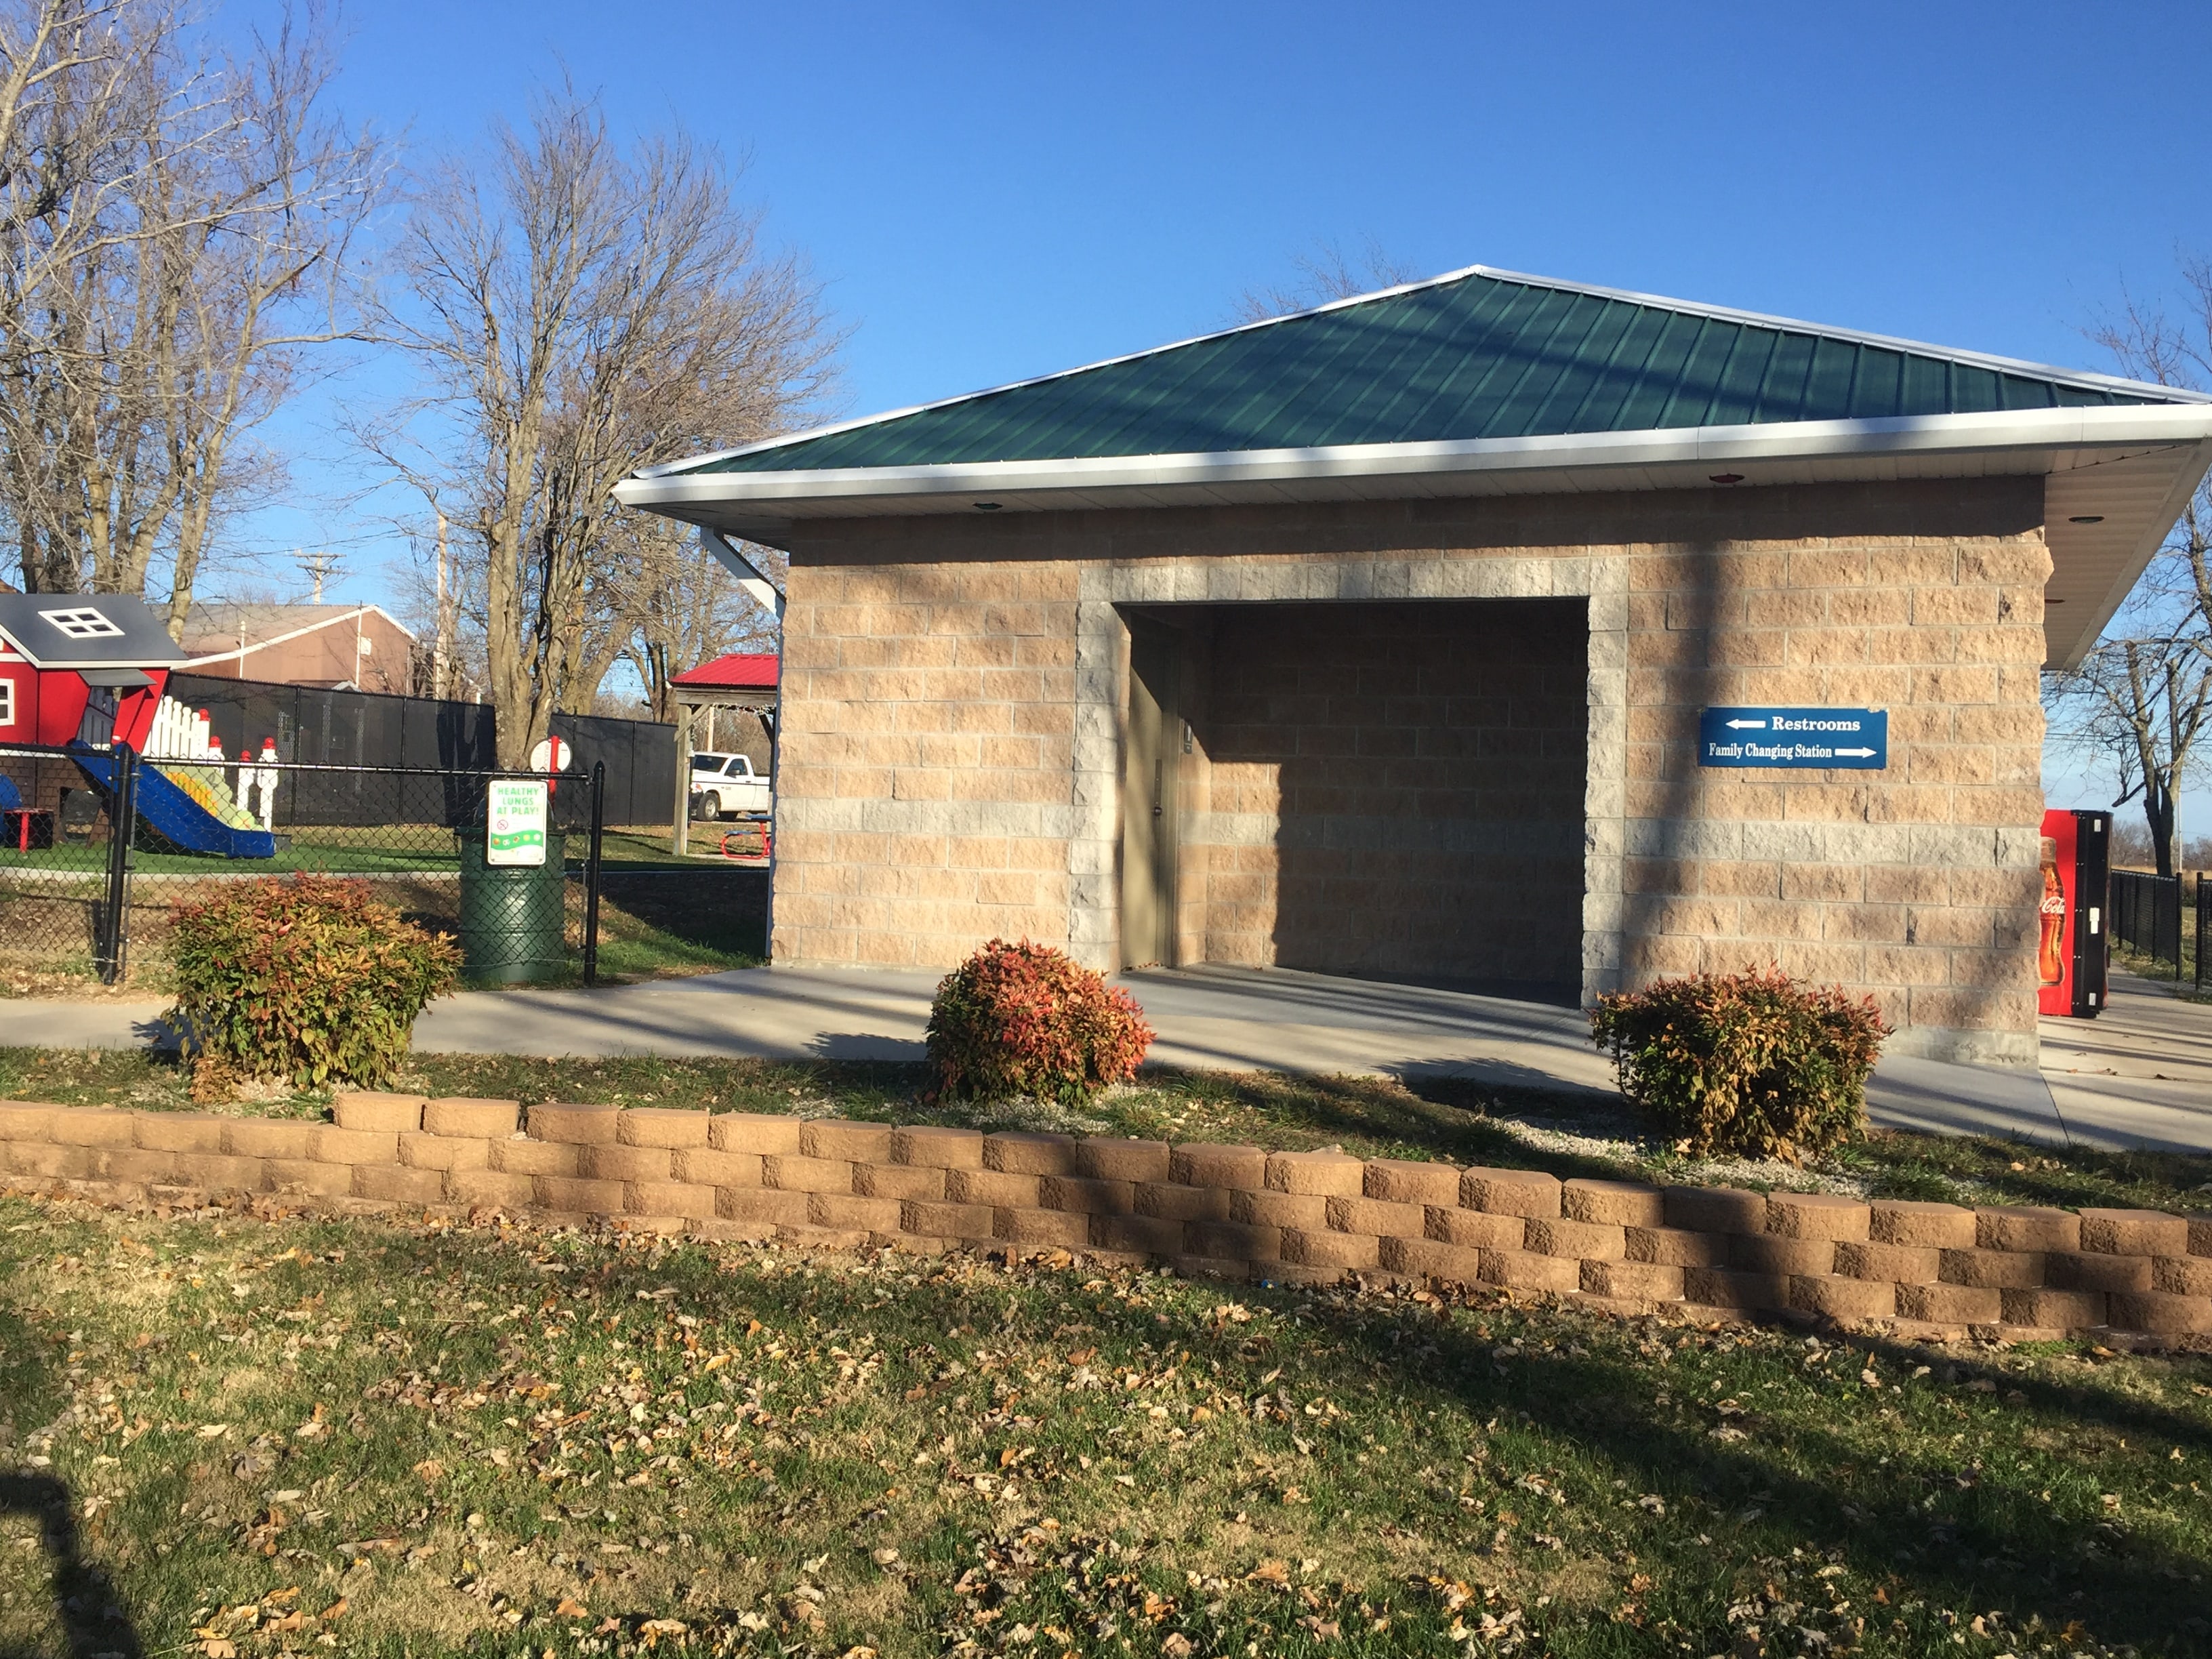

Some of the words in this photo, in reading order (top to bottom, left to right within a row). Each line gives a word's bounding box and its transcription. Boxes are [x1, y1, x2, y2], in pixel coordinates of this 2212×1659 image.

[1771, 716, 1860, 731] Restrooms
[1708, 743, 1742, 759] Family
[1745, 743, 1794, 760] Changing
[1795, 743, 1832, 758] Station
[497, 787, 539, 796] HEALTHY
[503, 797, 534, 806] LUNGS
[497, 806, 507, 815] AT
[512, 806, 539, 815] PLAY!
